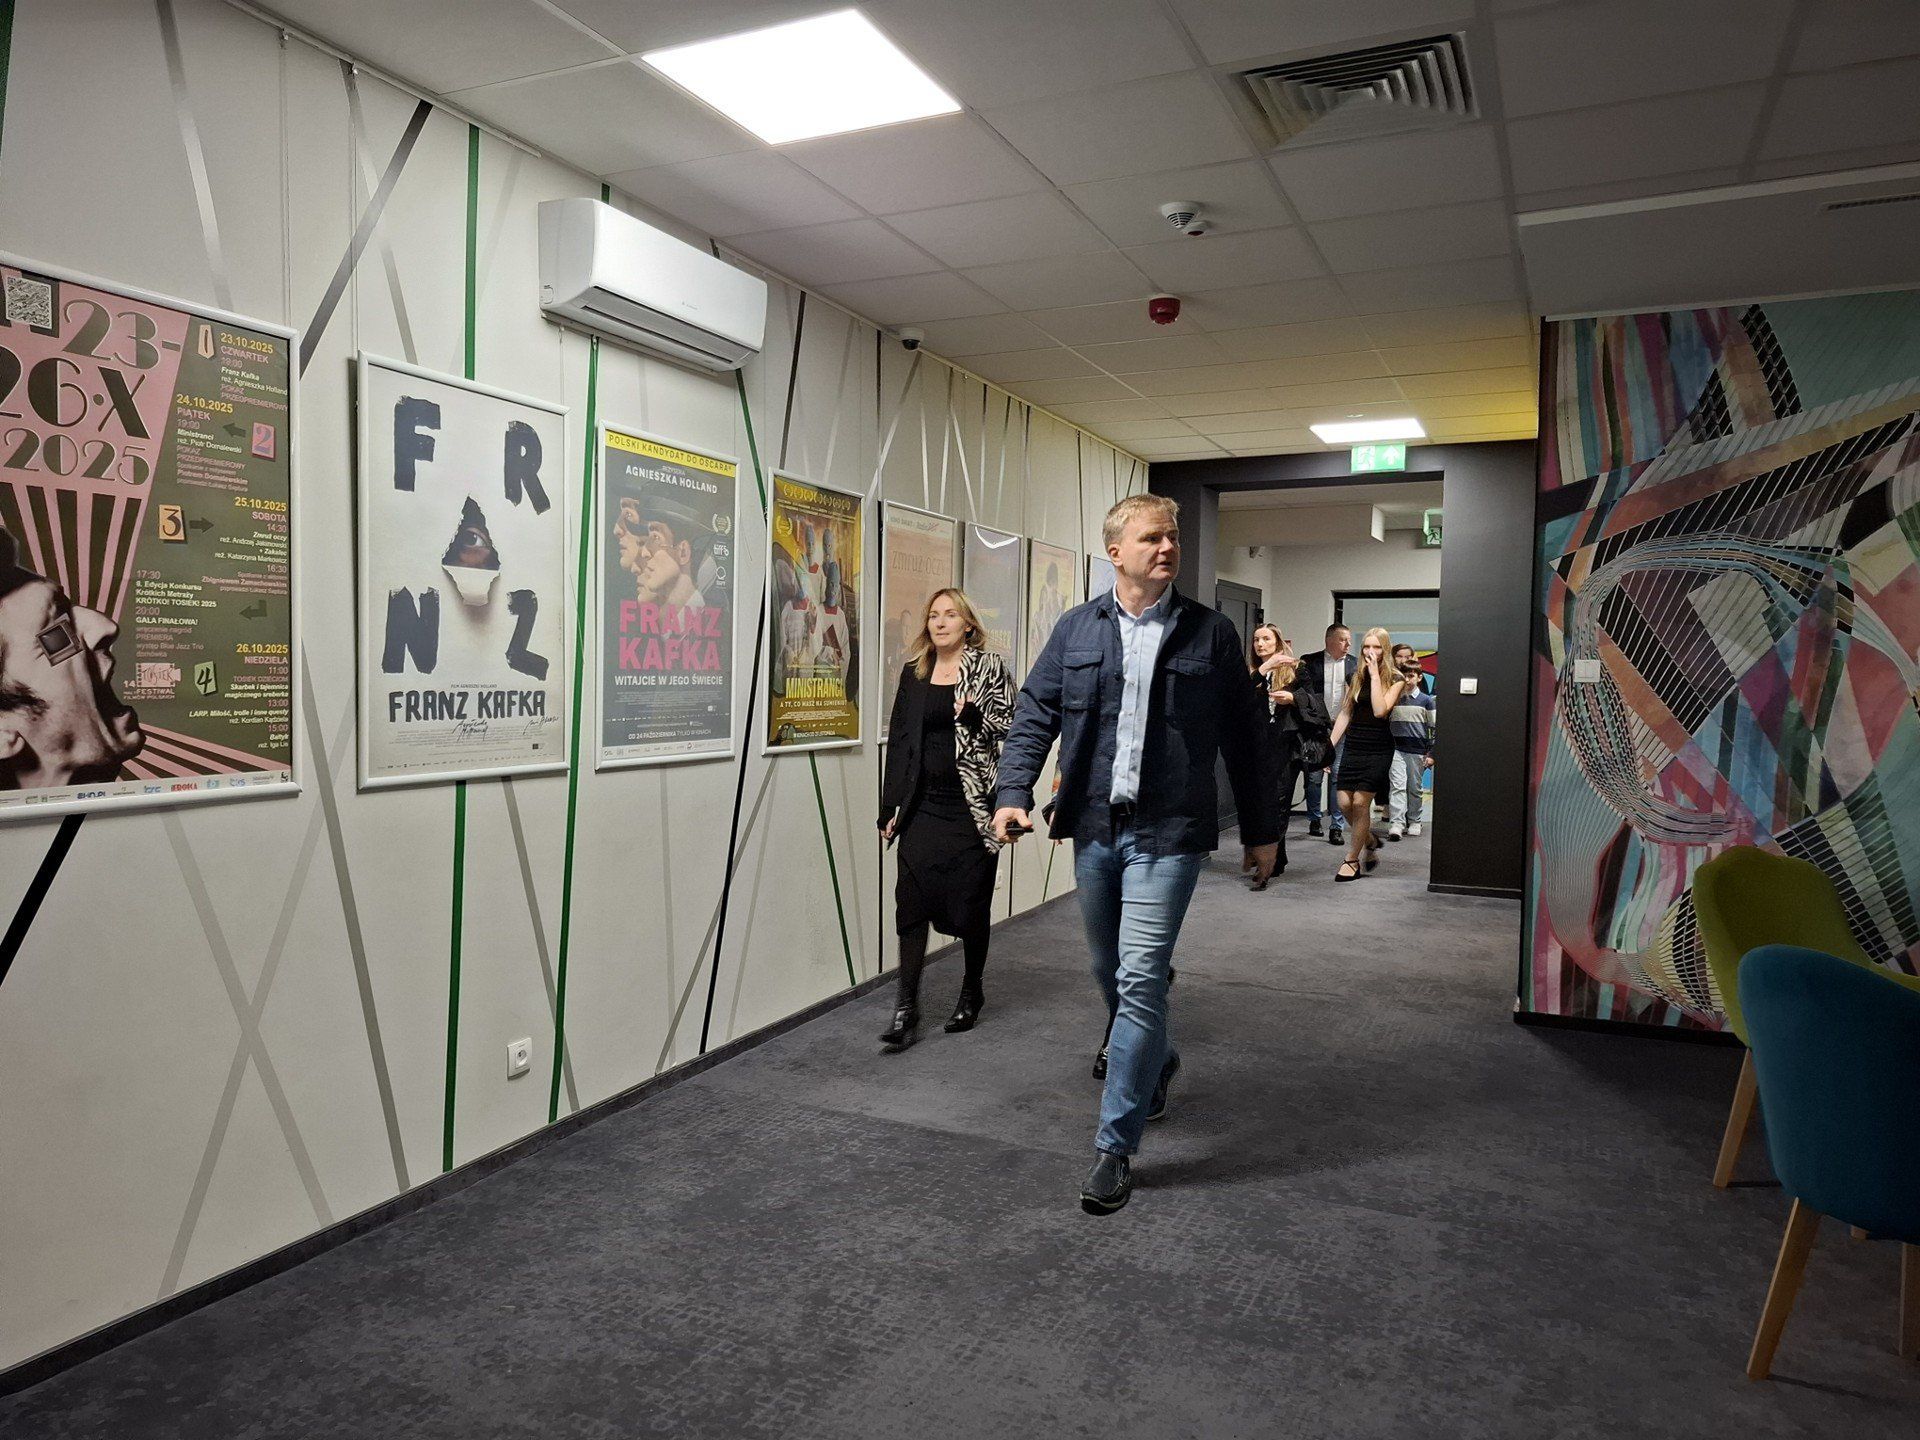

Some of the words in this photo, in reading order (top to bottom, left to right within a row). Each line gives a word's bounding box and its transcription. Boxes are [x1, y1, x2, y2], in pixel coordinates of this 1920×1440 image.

[64, 299, 181, 369] 23-
[220, 332, 274, 354] 23.10.2025
[221, 345, 269, 364] CZWARTEK
[221, 366, 240, 377] Franz
[266, 385, 288, 396] Holland
[176, 394, 234, 414] 24.10.2025
[255, 426, 272, 454] 2
[608, 434, 640, 449] POLSKI
[642, 443, 684, 461] KANDYDAT
[686, 454, 697, 464] DO
[4, 427, 151, 486] 2025
[394, 395, 441, 492] F
[503, 420, 551, 516] R
[625, 464, 678, 486] AGNIESZKA
[679, 478, 718, 494] HOLLAND
[235, 496, 287, 512] 25.10.2025
[162, 508, 182, 536] 3
[252, 511, 287, 522] SOBOTA
[267, 523, 287, 533] 14:30
[136, 570, 160, 580] 17:30
[267, 564, 287, 573] 16:30
[144, 581, 168, 590] Edycja
[135, 616, 157, 625] GALA
[619, 598, 723, 638] FRANZ
[382, 585, 441, 675] N
[505, 588, 550, 681] Z
[236, 643, 289, 653] 26.10.2025
[618, 636, 723, 672] KAFKA
[244, 656, 289, 664] NIEDZIELA
[197, 666, 213, 693] 4
[614, 675, 656, 686] WITAJCIE
[658, 675, 667, 685] W
[668, 675, 690, 685] JEGO
[691, 673, 723, 685] ŚWIECIE
[785, 677, 843, 699] MINISTRANCI
[268, 699, 289, 707] 13:00
[388, 690, 470, 723] FRANZ
[477, 689, 546, 720] KAFKA
